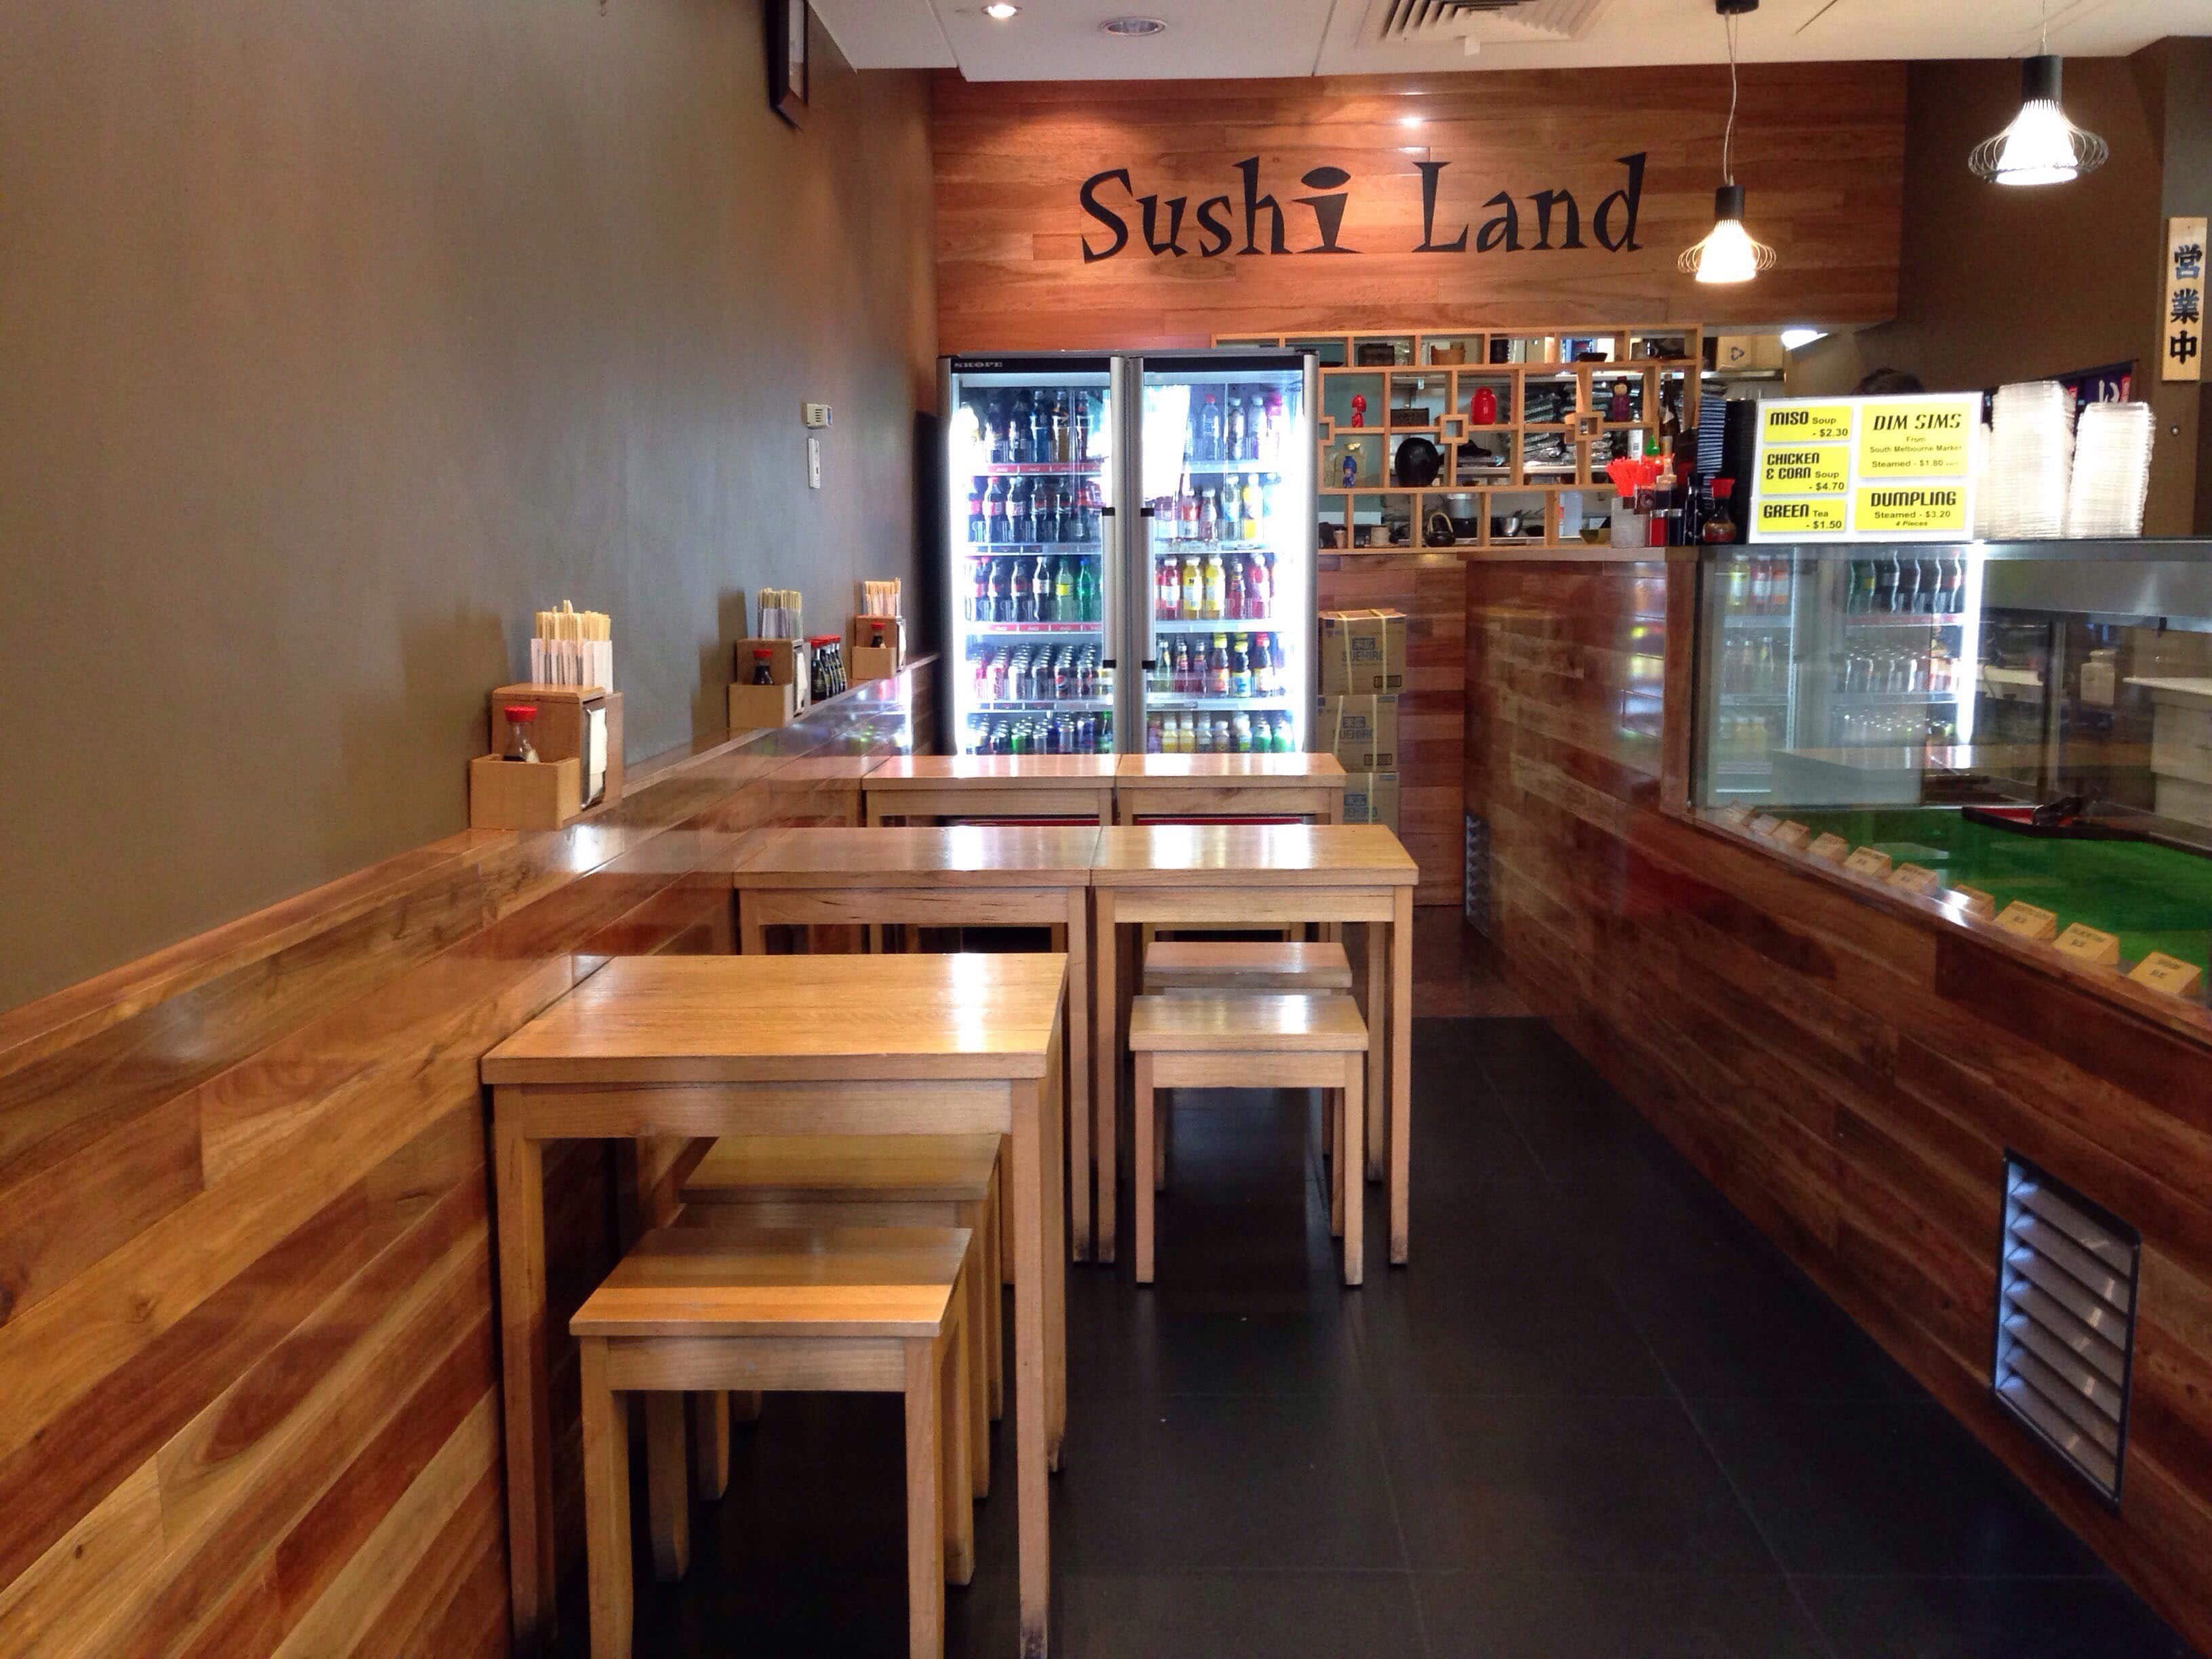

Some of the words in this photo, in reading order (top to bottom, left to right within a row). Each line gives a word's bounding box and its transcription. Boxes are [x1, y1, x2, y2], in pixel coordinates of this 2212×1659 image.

[1080, 155, 1363, 264] Sushi
[1412, 151, 1647, 253] Land
[2169, 243, 2203, 365] 営業中
[1769, 411, 1809, 426] MISO
[1872, 414, 1908, 430] DIM
[1914, 413, 1962, 430] SIMS
[1820, 428, 1848, 437] $2.30
[1767, 452, 1820, 466] CHICKEN
[1778, 467, 1811, 480] CORN
[1816, 482, 1845, 491] $4.70
[1870, 491, 1957, 507] DUMPLING
[1763, 504, 1809, 518] GREEN
[1875, 511, 1916, 519] Steamed
[1813, 520, 1842, 529] $1.50
